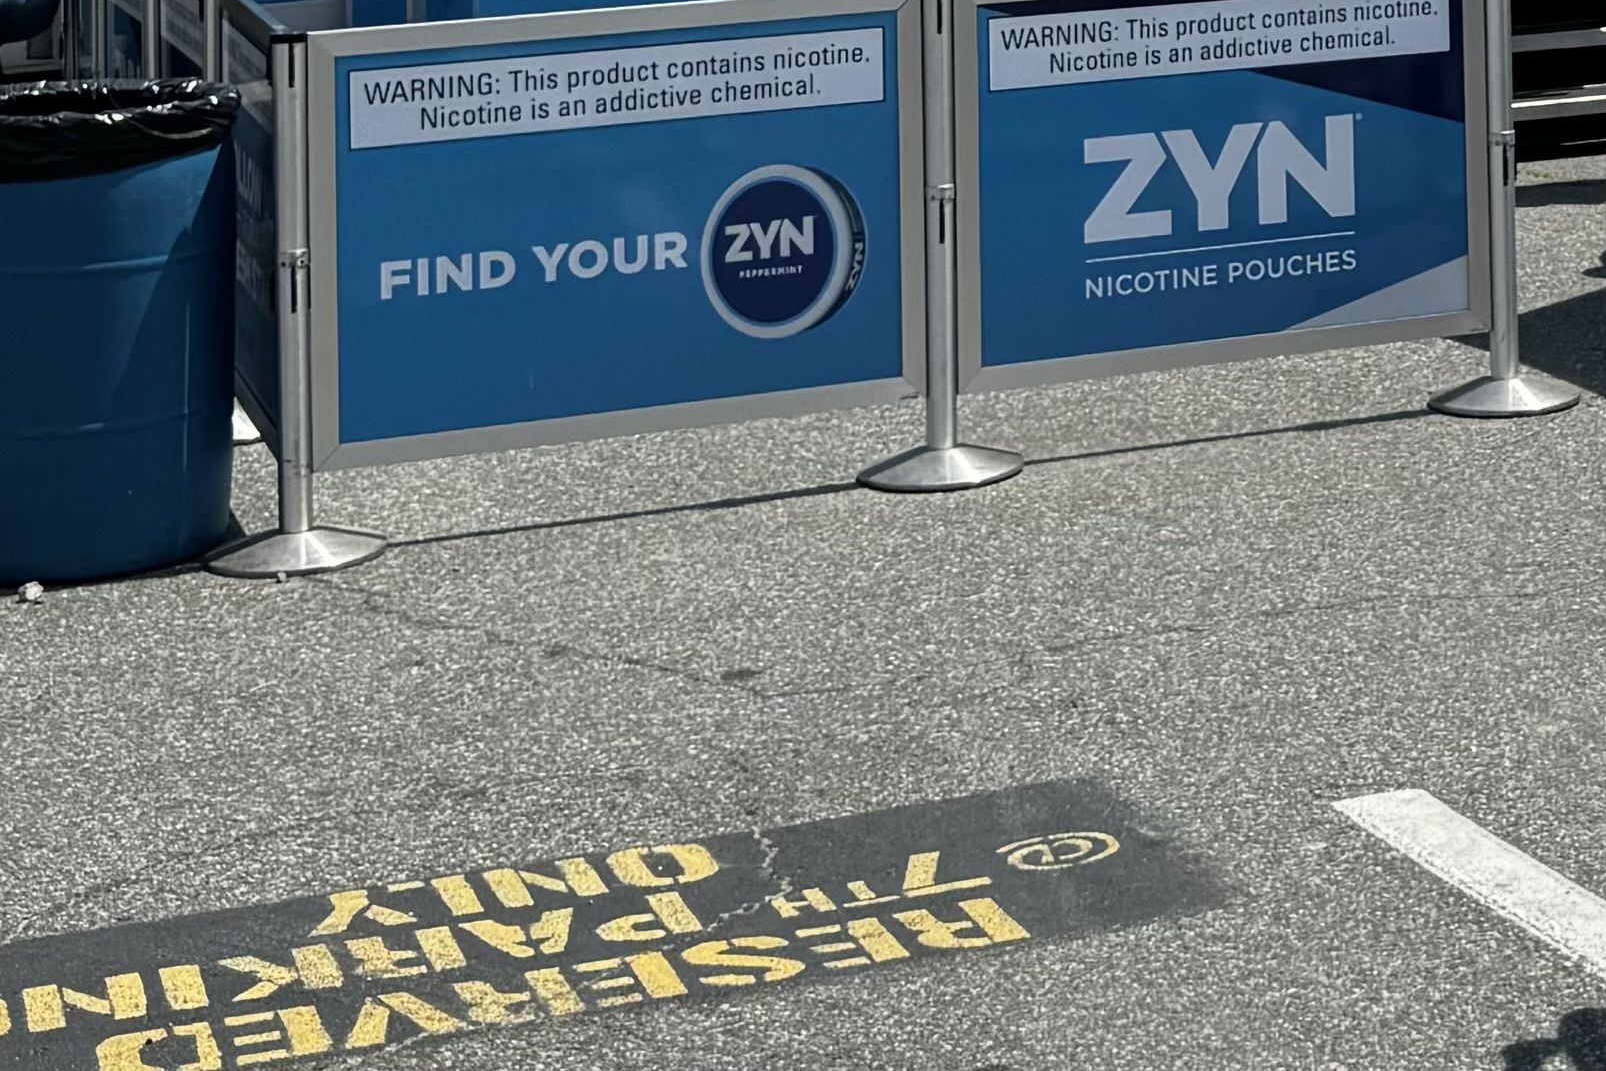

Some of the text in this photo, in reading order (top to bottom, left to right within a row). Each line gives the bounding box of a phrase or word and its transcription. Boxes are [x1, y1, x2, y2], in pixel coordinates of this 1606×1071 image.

[1001, 20, 1120, 51] WARNING:
[1126, 19, 1169, 41] This
[1175, 12, 1256, 41] product
[1261, 5, 1347, 29] contains
[1049, 26, 1396, 74] Nicotine is an addictive chemical.
[364, 44, 871, 106] WARNING: This product contains nicotine.
[420, 74, 821, 131] Nicotine is an addictive chemical.
[1083, 113, 1356, 245] ZYN
[380, 231, 689, 300] FIND YOUR
[724, 215, 814, 263] ZYN
[845, 241, 864, 290] ZYN
[739, 265, 803, 279] PEPPERMINT
[1085, 249, 1358, 300] NICOTINE POUCHES
[308, 844, 720, 937] ONLY
[777, 850, 992, 920] 7TH
[0, 891, 704, 1036] PARKIN
[95, 897, 1030, 1071] RESERVED
